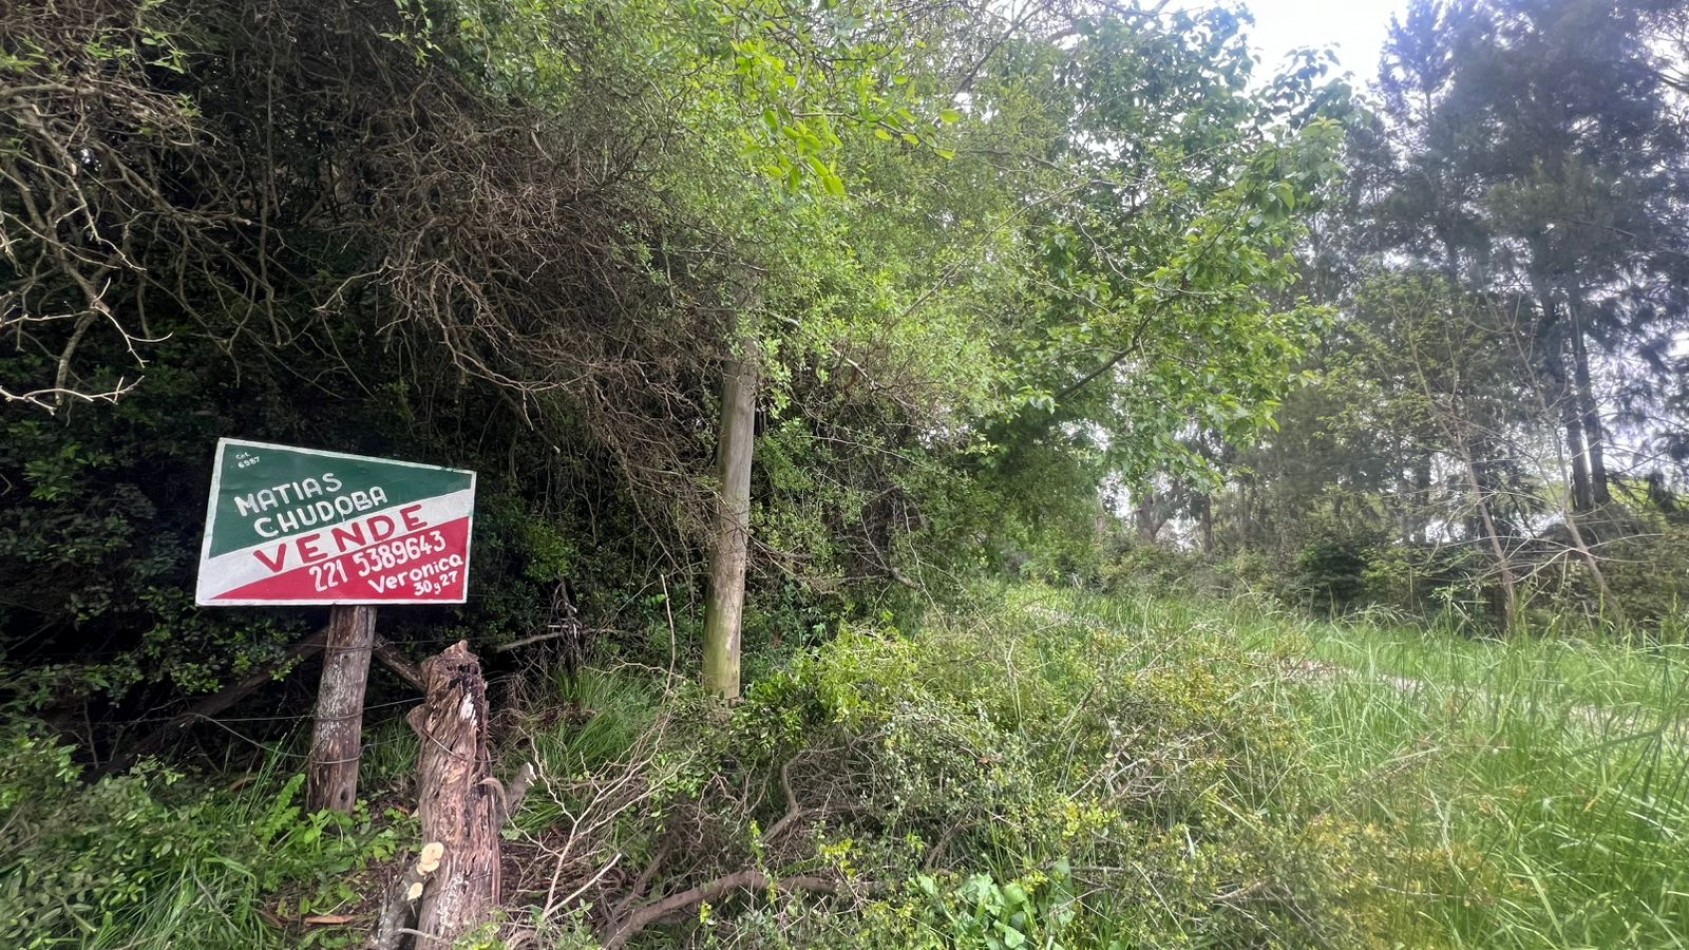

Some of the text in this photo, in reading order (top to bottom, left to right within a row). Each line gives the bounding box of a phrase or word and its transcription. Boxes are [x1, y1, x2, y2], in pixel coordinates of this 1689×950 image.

[234, 472, 341, 517] MATIAS
[254, 489, 388, 537] CHUDOBA
[253, 504, 428, 573] VENDE
[308, 530, 446, 592] 221 5389643
[368, 553, 463, 594] Veronica
[413, 581, 432, 596] 30
[439, 570, 459, 586] 27
